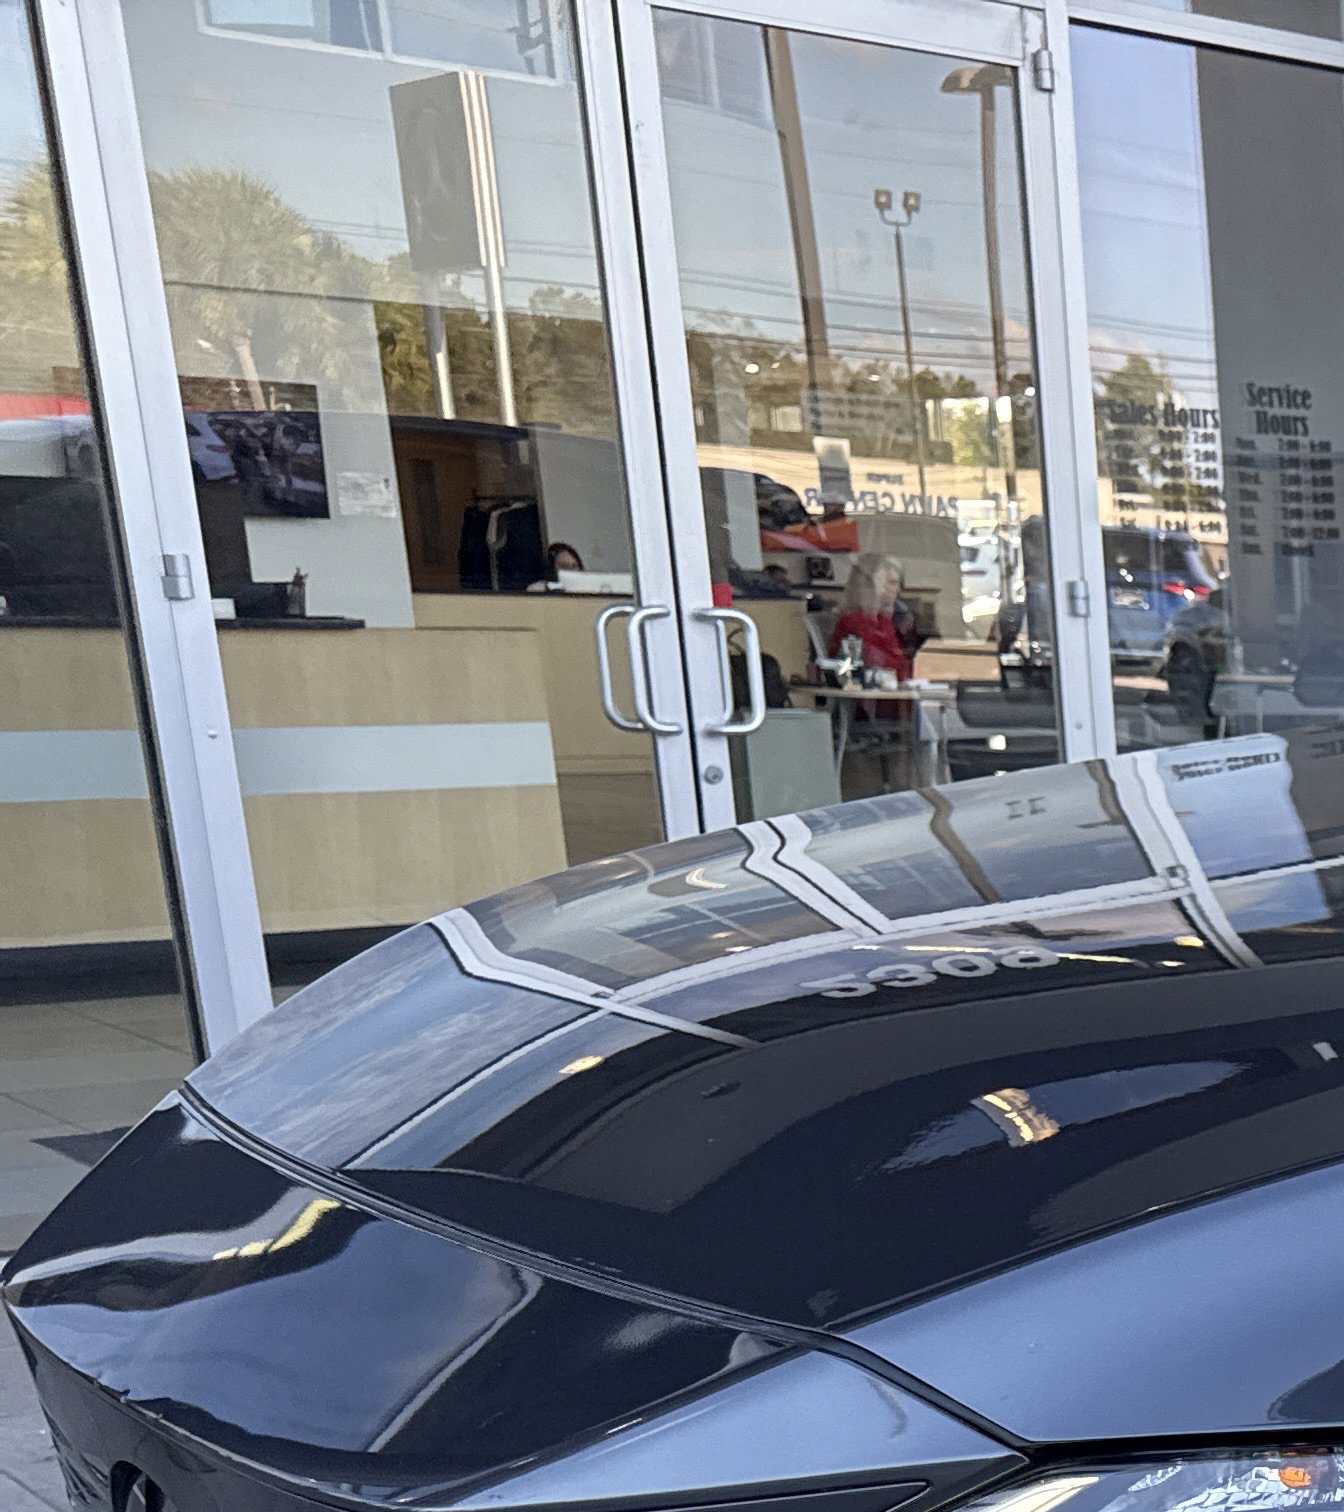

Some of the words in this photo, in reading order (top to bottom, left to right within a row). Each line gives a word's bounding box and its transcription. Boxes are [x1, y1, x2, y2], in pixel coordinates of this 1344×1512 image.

[1245, 381, 1312, 411] Service
[1163, 402, 1220, 429] Hours
[1254, 410, 1310, 437] Hours
